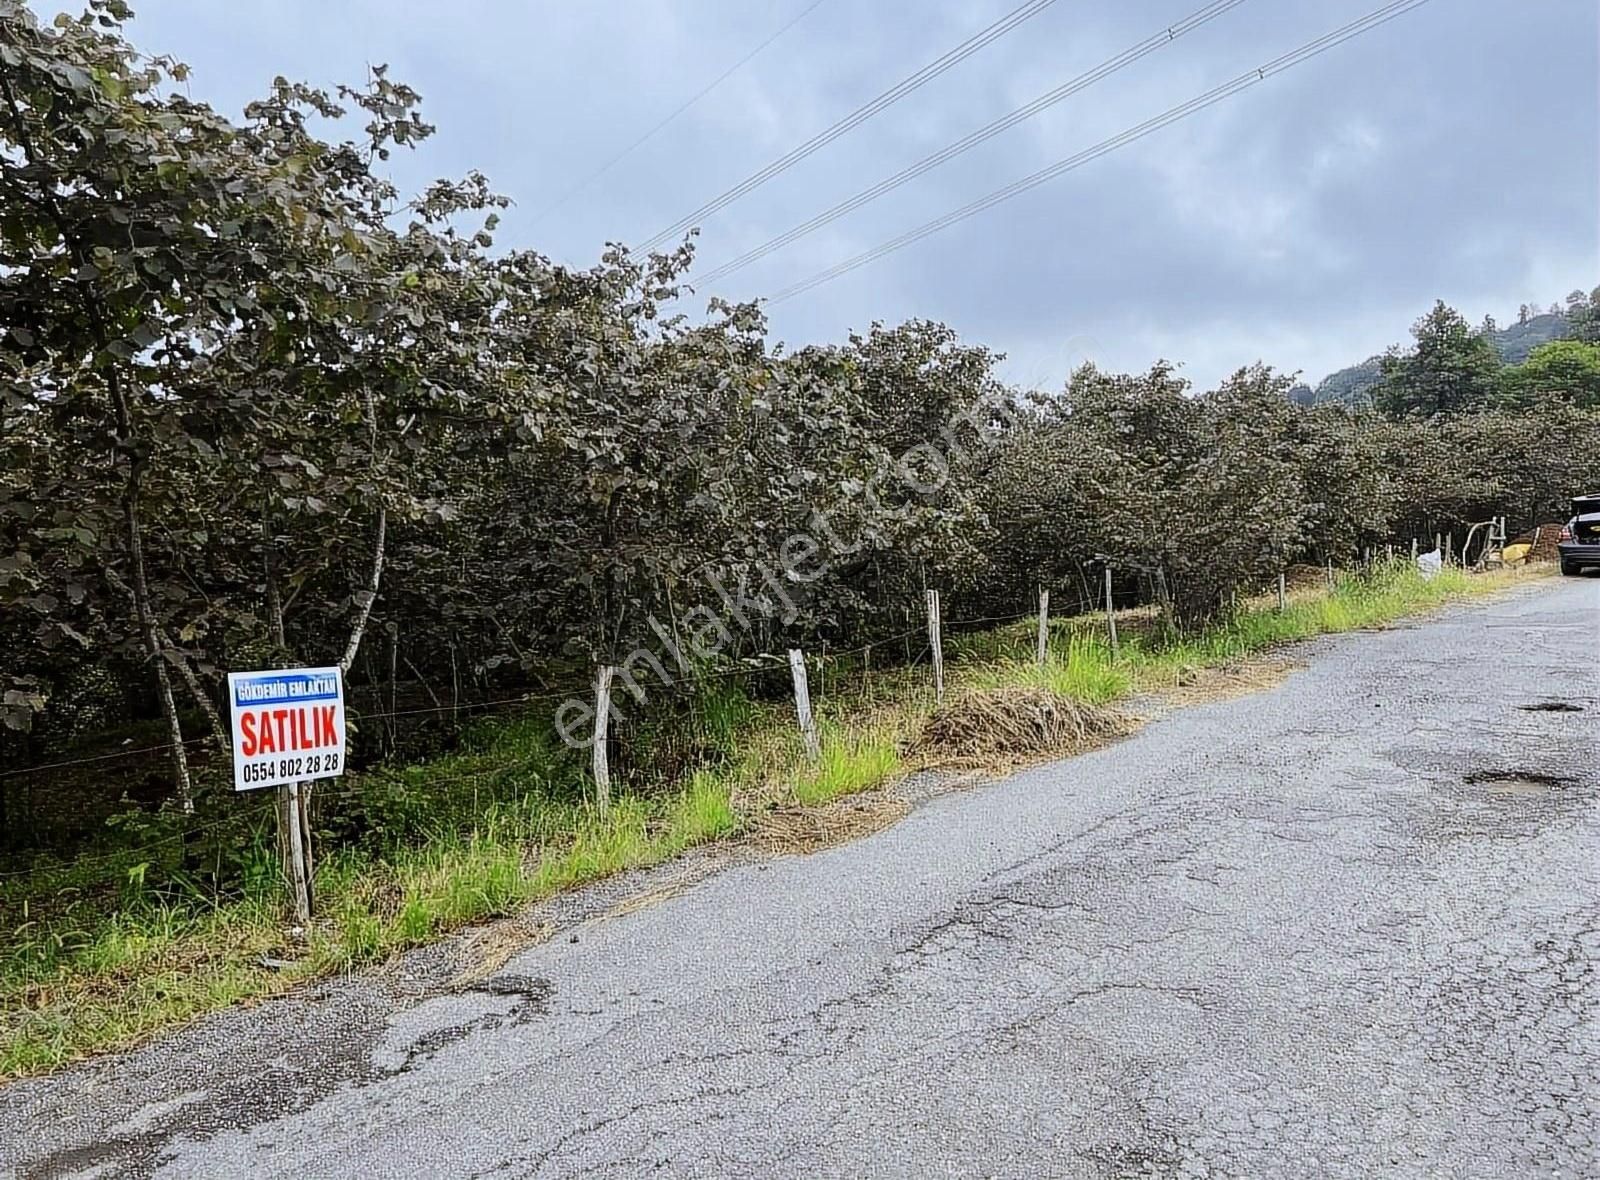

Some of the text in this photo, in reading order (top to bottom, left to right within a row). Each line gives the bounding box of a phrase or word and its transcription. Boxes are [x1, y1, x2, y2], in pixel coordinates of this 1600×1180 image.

[240, 705, 338, 757] SATILIK
[243, 753, 339, 783] 0554 802 28 28
